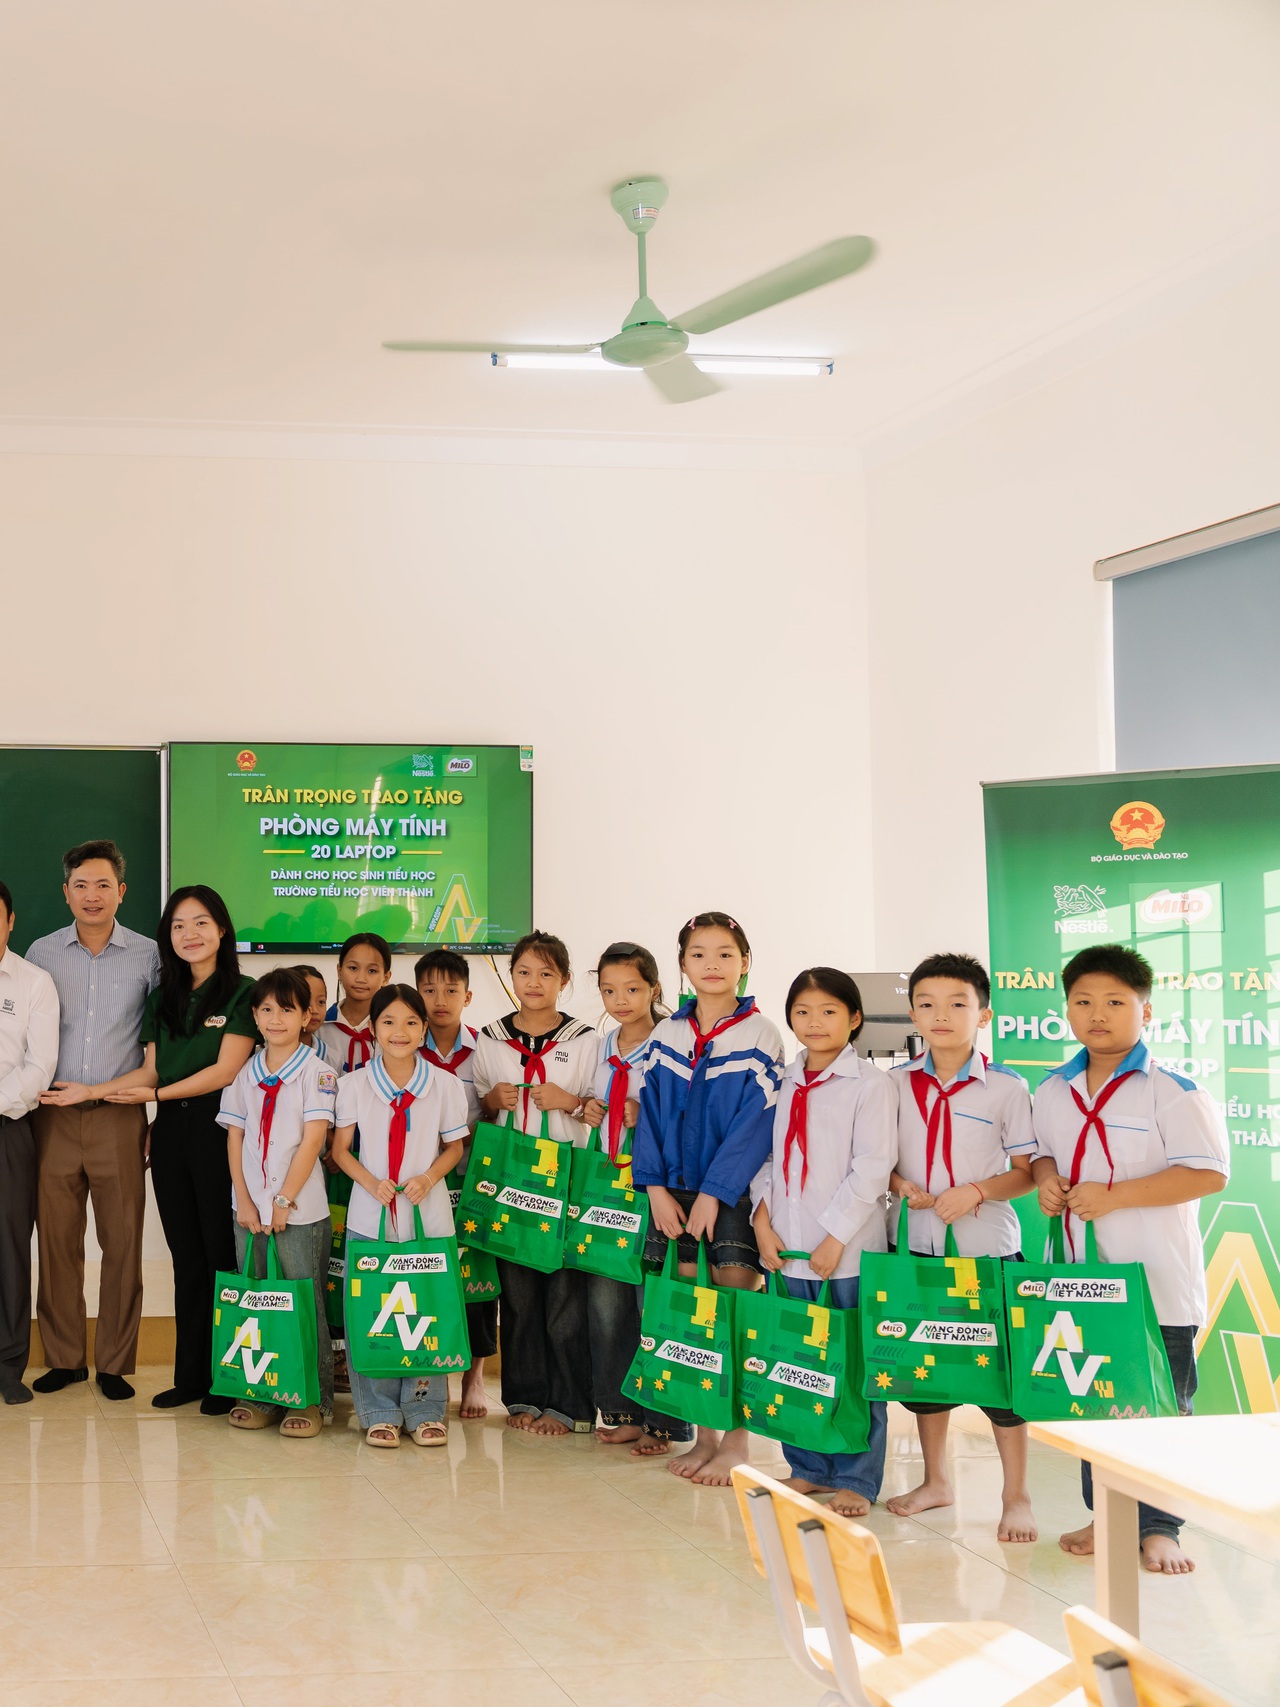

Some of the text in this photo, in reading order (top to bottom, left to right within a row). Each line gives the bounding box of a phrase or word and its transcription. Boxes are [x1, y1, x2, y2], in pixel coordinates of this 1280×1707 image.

[242, 785, 463, 808] TRÂN TRỌNG TRAO TẶNG
[260, 813, 446, 836] PHÒNG MÁY TÍNH
[311, 845, 396, 859] 20 LAPTOP
[1091, 852, 1188, 863] BỘ GIÁO DỤC VÀ ĐÀO TẠO
[271, 866, 435, 882] DÀNH CHO HỌC SINH TIỂU HỌC
[273, 883, 433, 898] TRƯỜNG TIỂU HỌC VIÊN THÀNH
[1151, 900, 1204, 913] MILO
[995, 967, 1055, 989] TRÂN
[1156, 967, 1280, 995] TRAO TẶN
[998, 1009, 1076, 1040] PHÒ
[1140, 1011, 1280, 1045] MÁY TÍN
[480, 1184, 495, 1192] MILO
[1075, 1290, 1102, 1298] NAM
[951, 1333, 975, 1341] NAM
